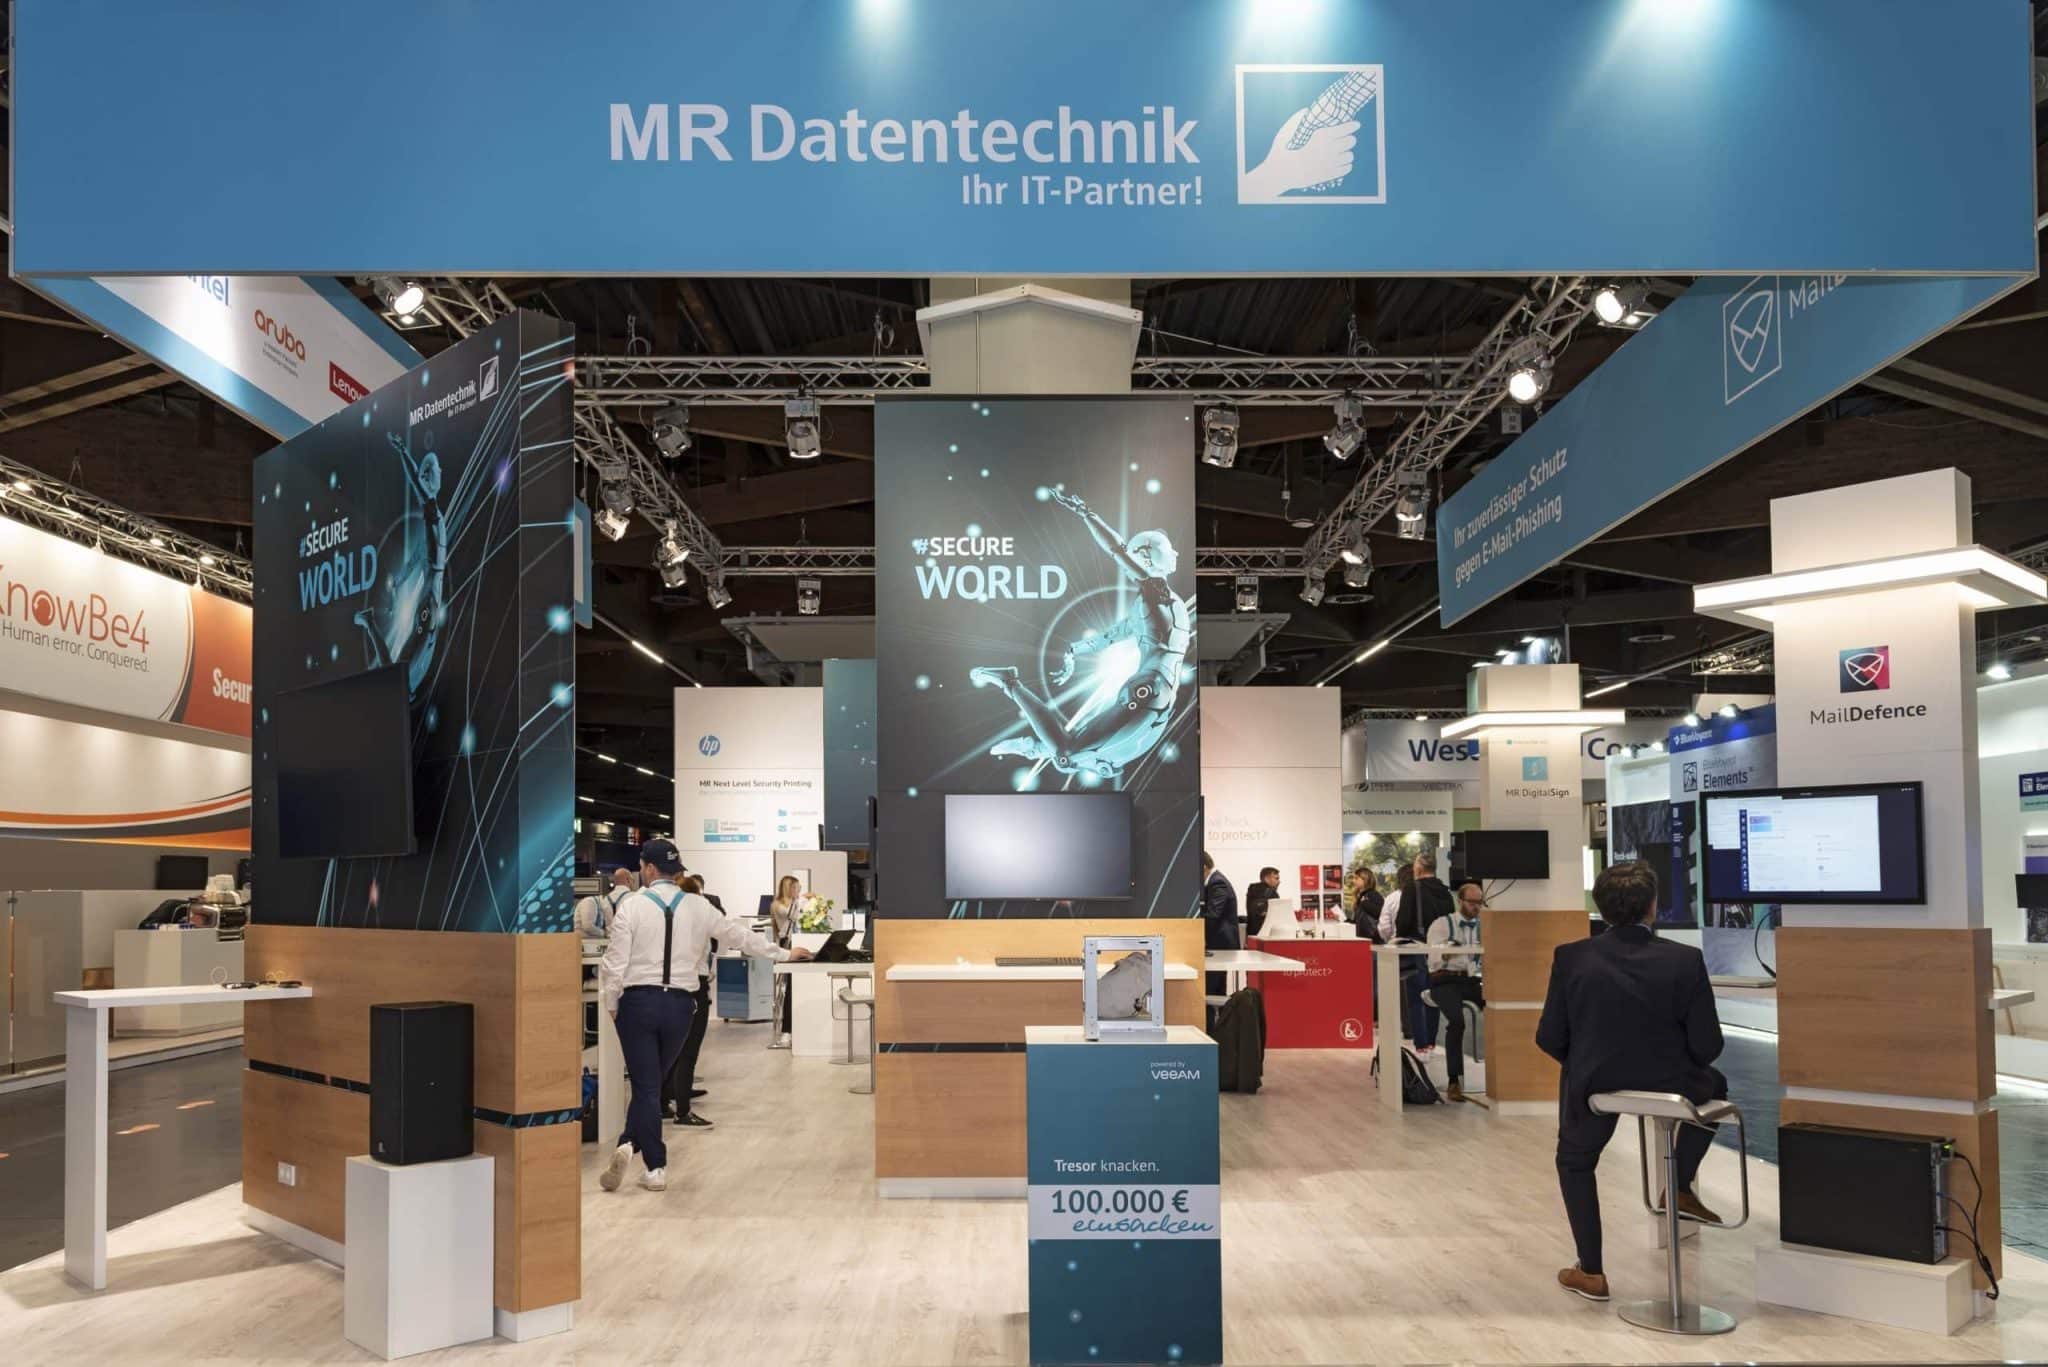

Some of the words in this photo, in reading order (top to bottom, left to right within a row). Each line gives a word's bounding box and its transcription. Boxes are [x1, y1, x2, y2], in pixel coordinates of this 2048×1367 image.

[610, 103, 734, 161] MR
[750, 104, 1200, 163] Datentechnik
[962, 173, 1008, 204] Ihr
[1022, 175, 1202, 205] IT-Partner!
[254, 309, 306, 360] aruba
[409, 406, 424, 426] MR
[424, 379, 477, 419] Datentechnik
[1454, 527, 1466, 549] Ihr
[1467, 478, 1528, 541] zuverlässiger
[1529, 447, 1568, 492] Schutz
[299, 517, 349, 558] #SECURE
[914, 536, 1015, 557] #SECURE
[1455, 551, 1481, 588] gegen
[1482, 495, 1562, 564] E-Mail-Phishing
[299, 544, 377, 612] WORLD
[915, 564, 1068, 601] WORLD
[2, 618, 50, 648] Human
[53, 634, 85, 657] error.
[87, 642, 150, 673] Conquered.
[1810, 704, 1927, 725] MailDefence
[699, 735, 721, 757] hp
[713, 779, 731, 788] Next
[732, 779, 752, 788] Level
[753, 779, 782, 789] Security
[783, 779, 813, 789] Printing
[1506, 788, 1520, 797] MR
[1054, 1159, 1097, 1172] Tresor
[1100, 1159, 1160, 1173] knacken.
[1052, 1190, 1164, 1213] 100.000
[1172, 1190, 1190, 1213] €
